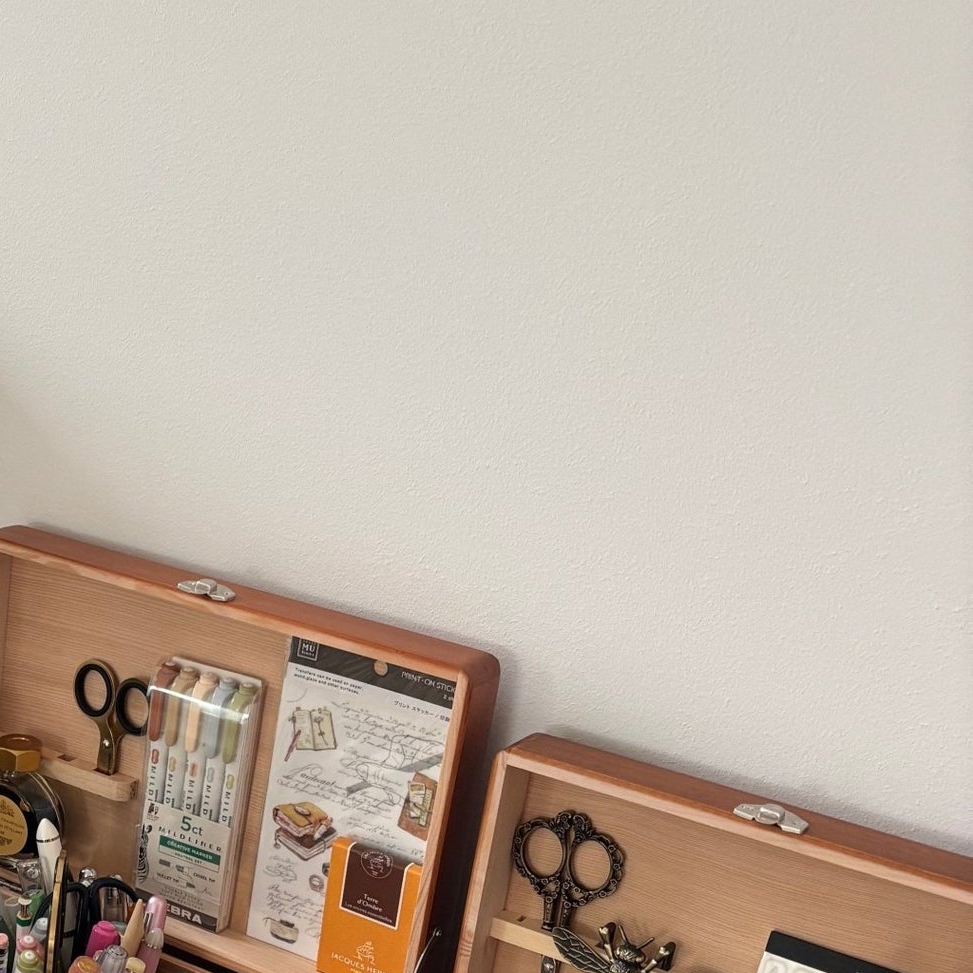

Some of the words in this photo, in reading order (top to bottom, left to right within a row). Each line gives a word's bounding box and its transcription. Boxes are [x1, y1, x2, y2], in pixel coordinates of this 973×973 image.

[401, 671, 435, 687] PRINT-ON
[180, 815, 204, 837] 5ct
[158, 826, 222, 852] MILDLINER
[166, 903, 203, 925] EBRA
[330, 952, 366, 971] JACQUES
